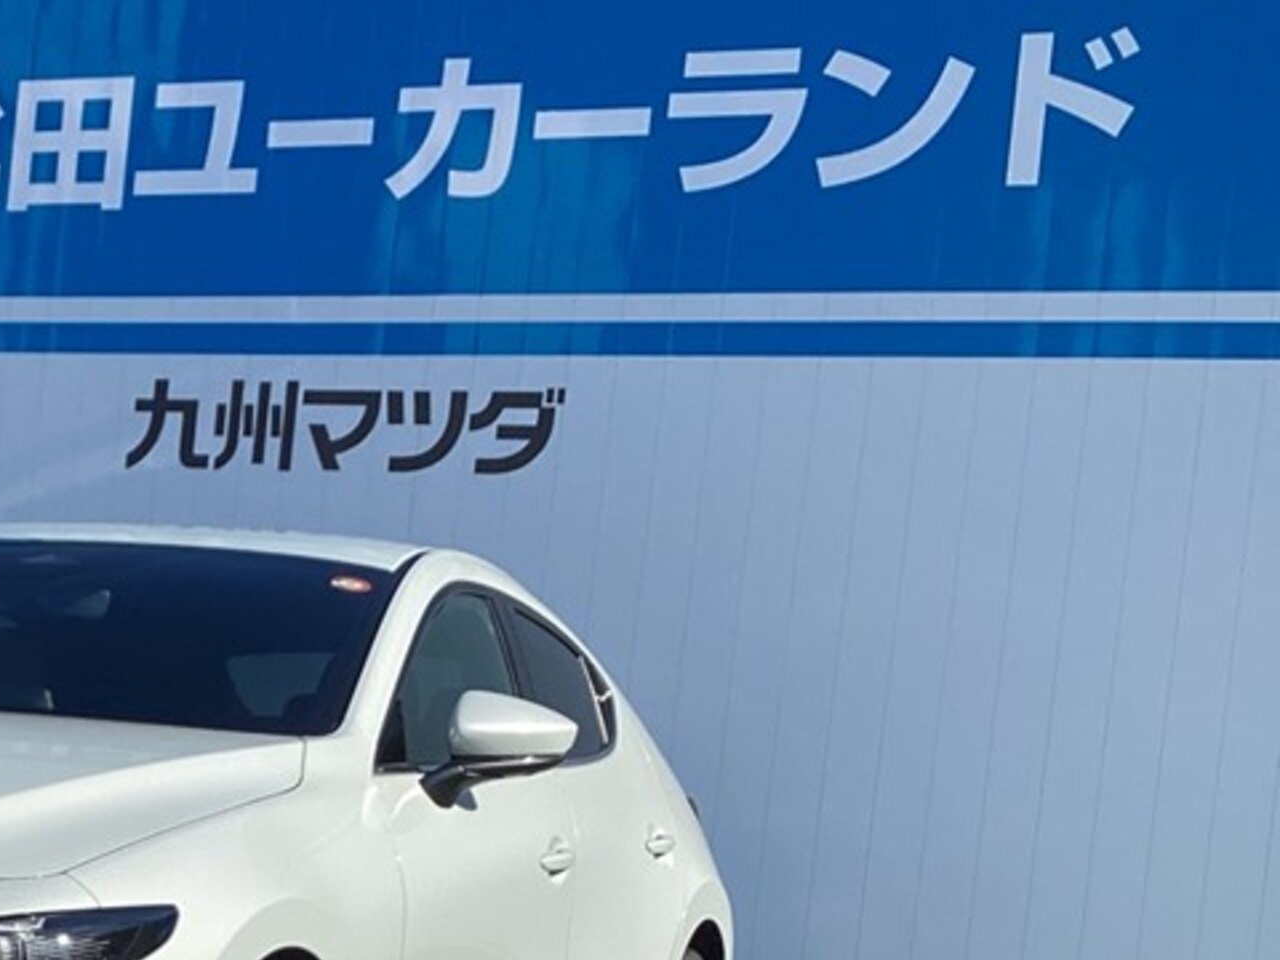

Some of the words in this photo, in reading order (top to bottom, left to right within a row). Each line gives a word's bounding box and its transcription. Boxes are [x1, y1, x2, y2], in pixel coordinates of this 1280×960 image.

[125, 378, 565, 475] 九州マツダ
